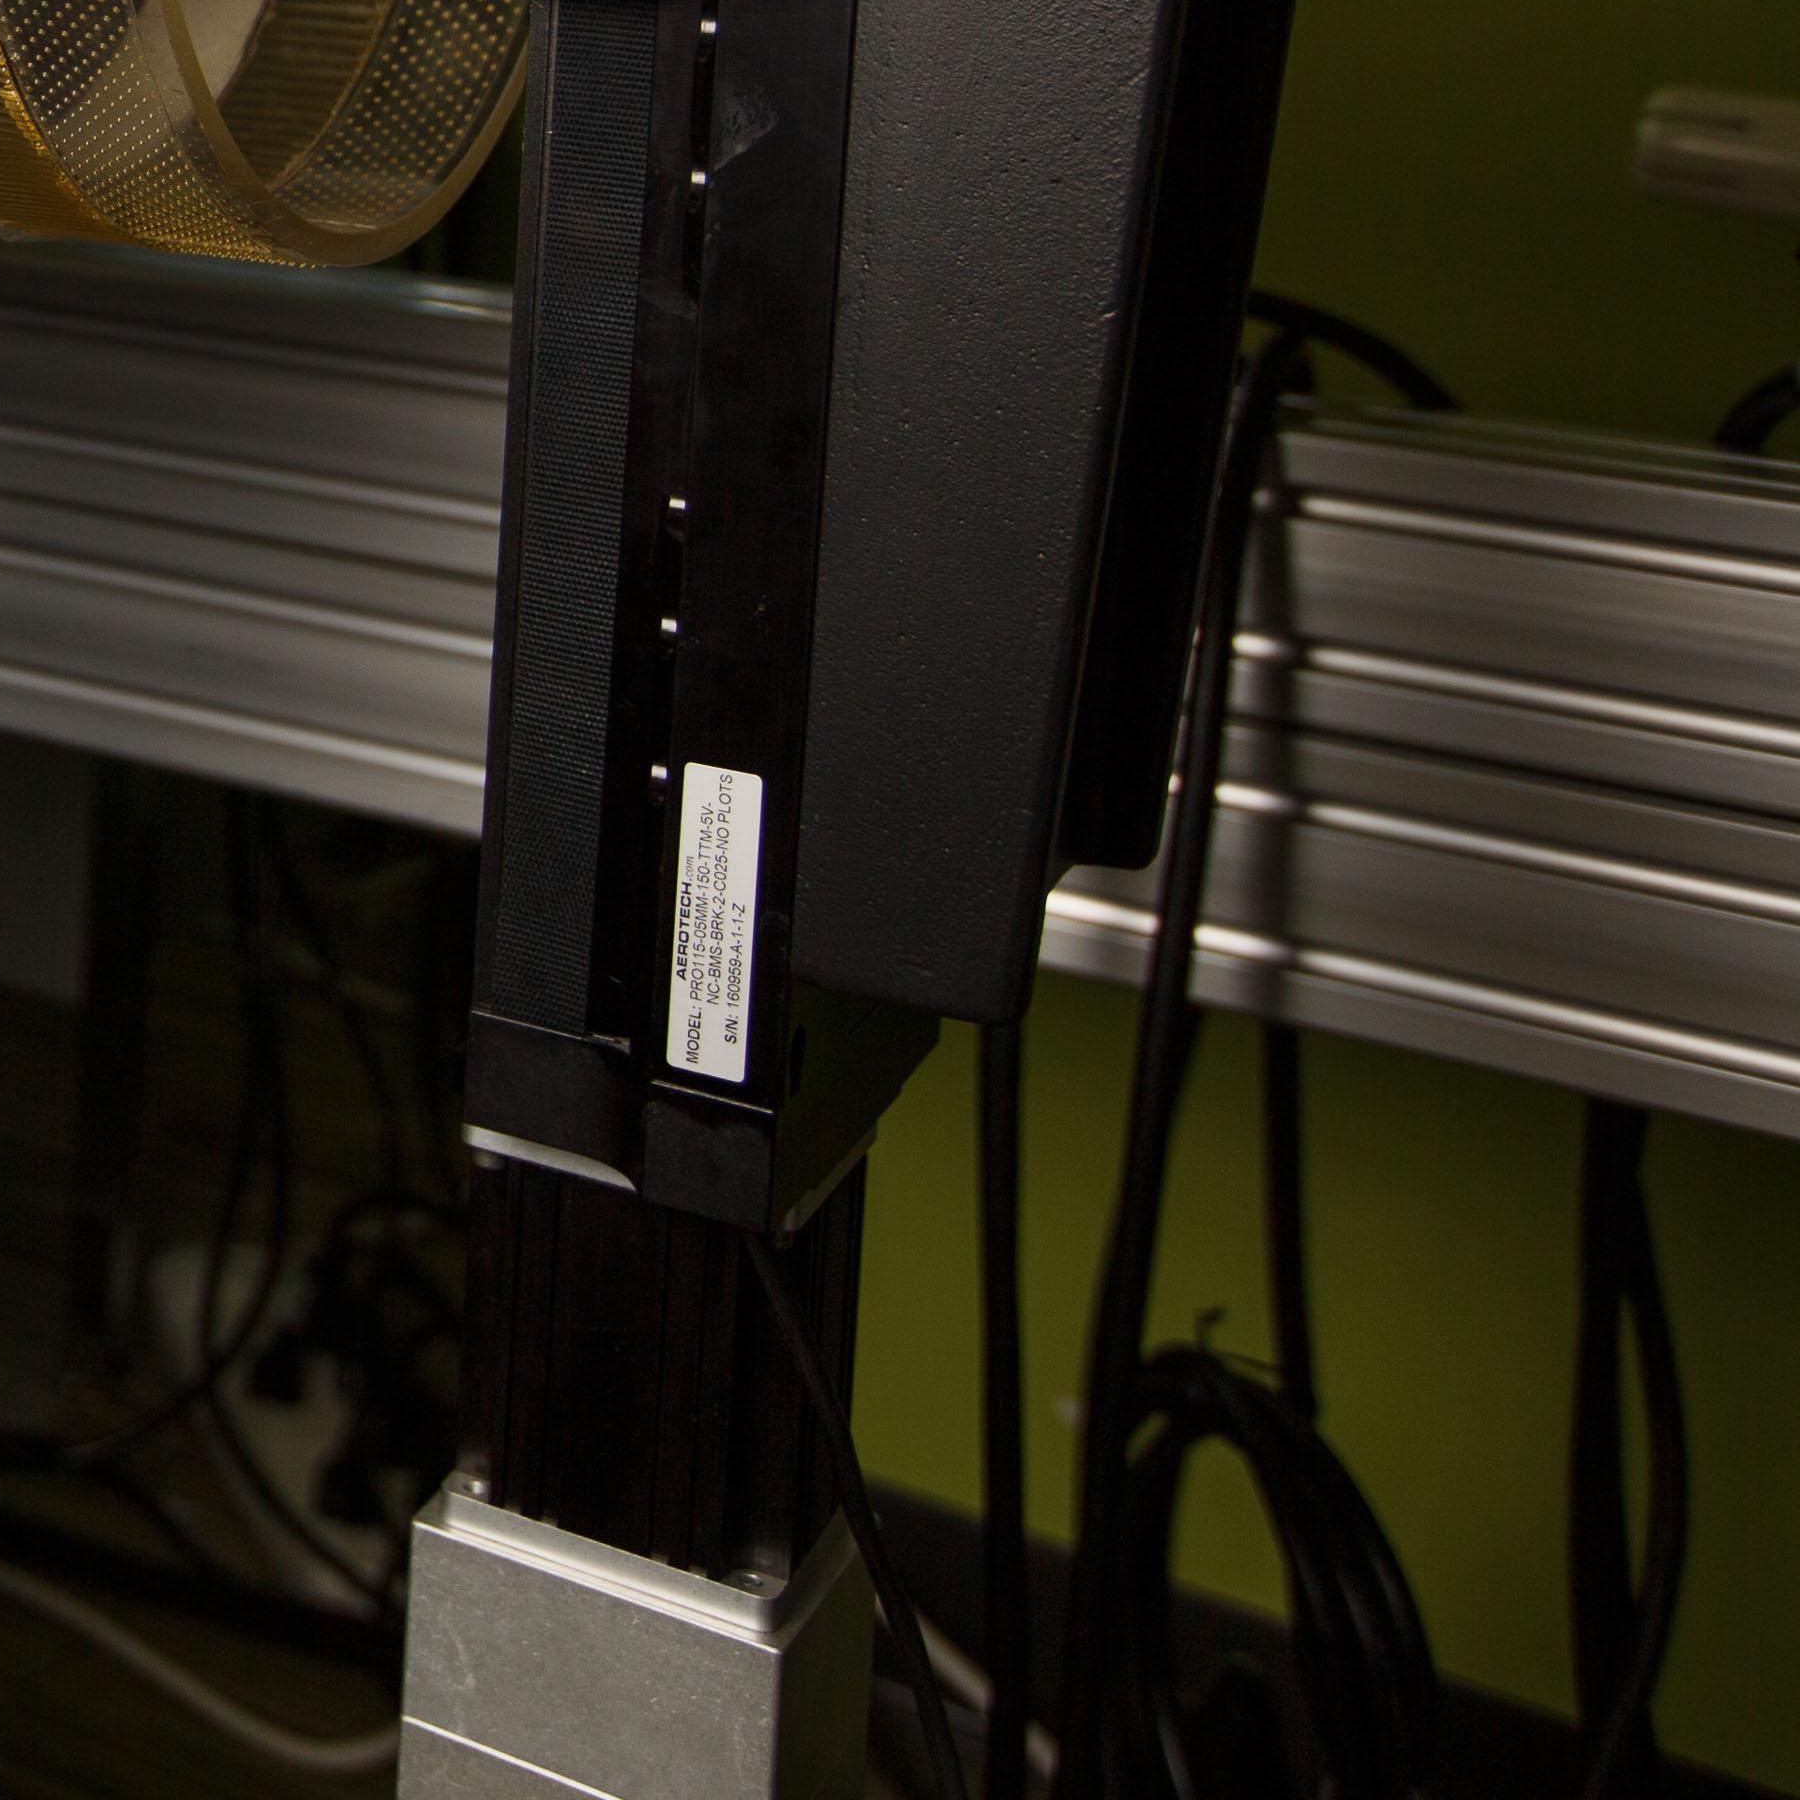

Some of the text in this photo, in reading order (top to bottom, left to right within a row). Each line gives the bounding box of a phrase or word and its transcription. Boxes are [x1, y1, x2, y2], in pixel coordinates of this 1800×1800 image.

[717, 774, 733, 824] PLOTS
[724, 902, 746, 1045] S/N: 160959-A-1-1-Z
[686, 1005, 702, 1065] MODEL:
